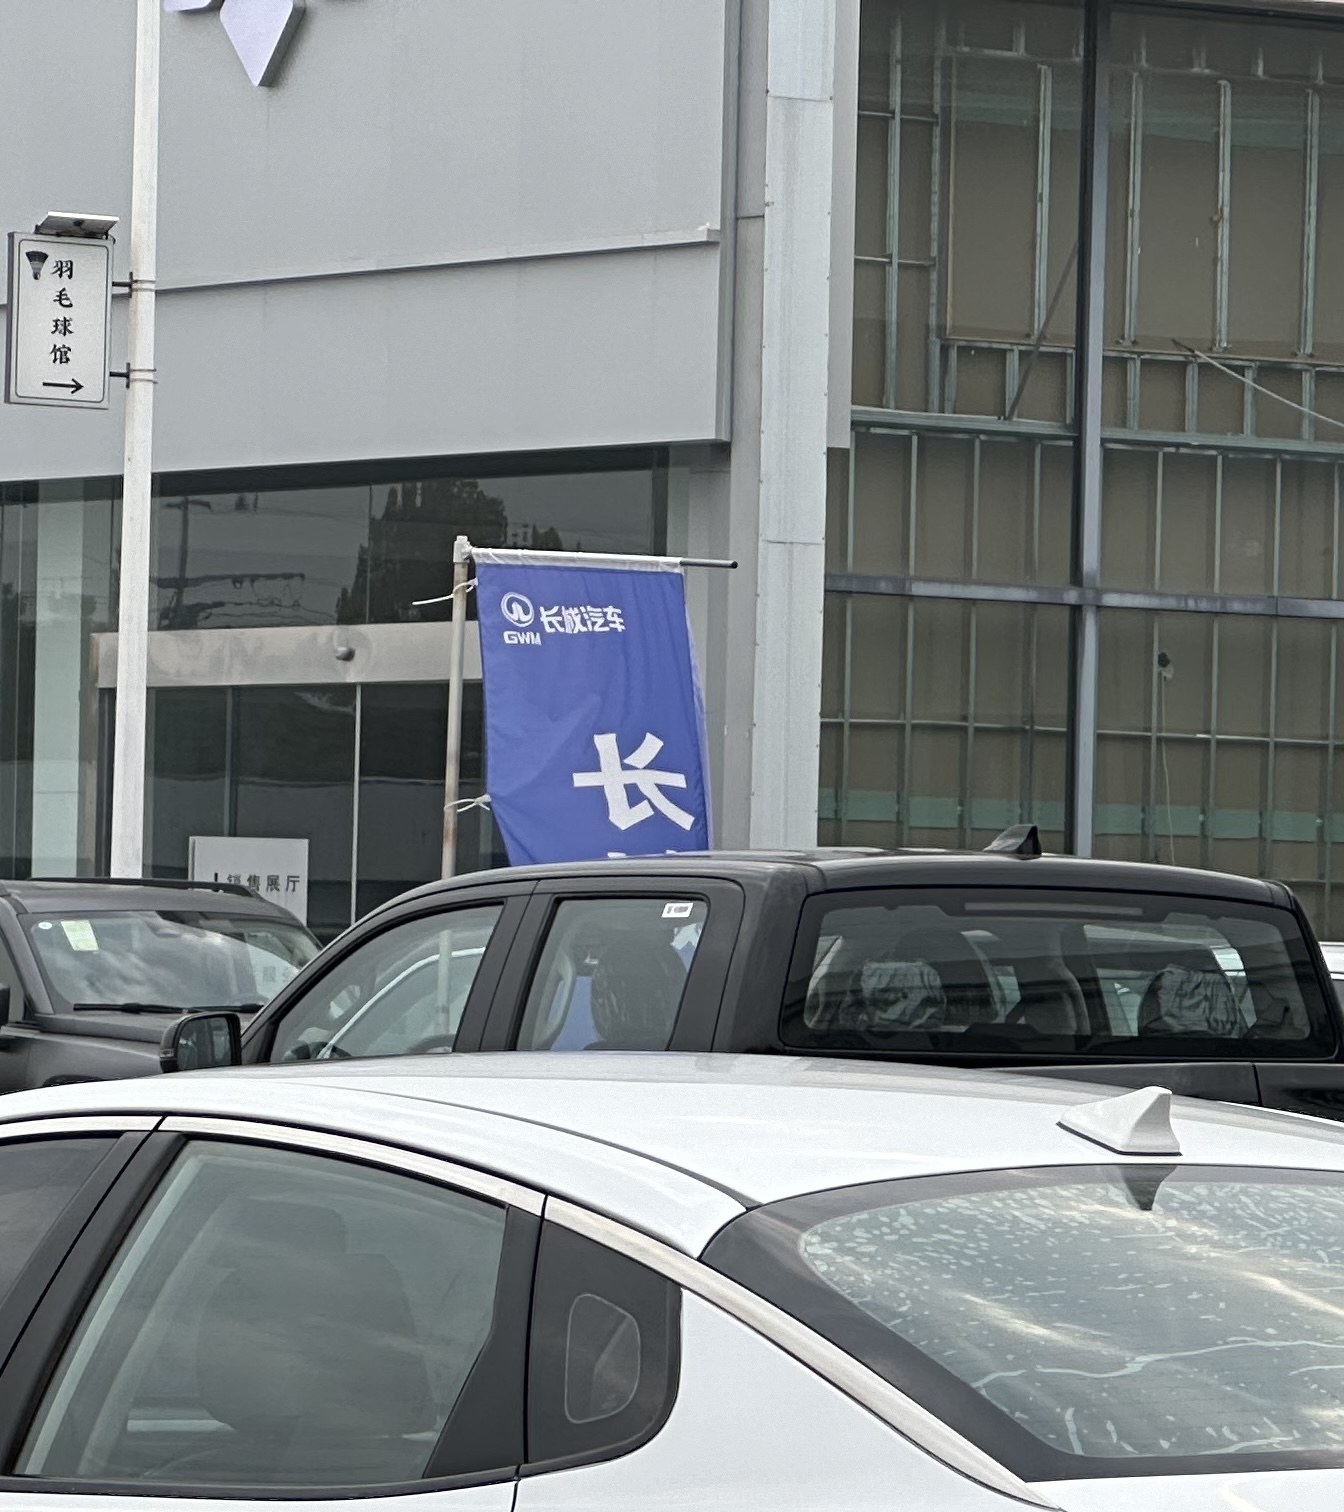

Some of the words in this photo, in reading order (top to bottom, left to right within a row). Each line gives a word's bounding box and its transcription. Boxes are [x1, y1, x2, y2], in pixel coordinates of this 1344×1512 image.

[50, 259, 75, 365] 羽毛球馆
[573, 733, 695, 856] 长
